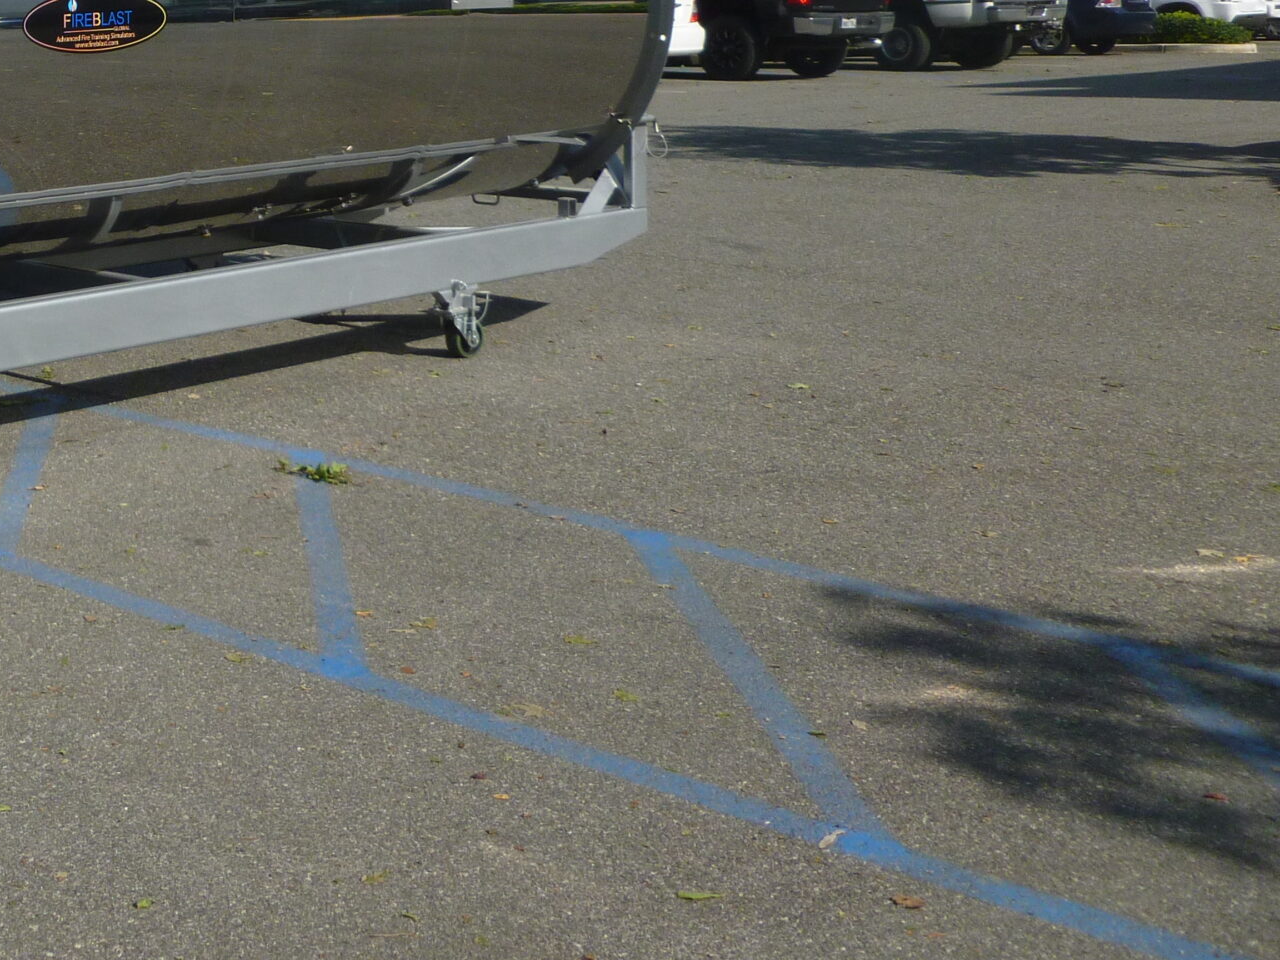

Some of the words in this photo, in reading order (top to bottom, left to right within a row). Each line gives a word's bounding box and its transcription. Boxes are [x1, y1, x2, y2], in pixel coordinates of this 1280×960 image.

[63, 10, 132, 28] FIREBLAST
[56, 35, 81, 43] Advanced
[91, 33, 110, 41] Training
[74, 40, 119, 48] www.fireblast.com
